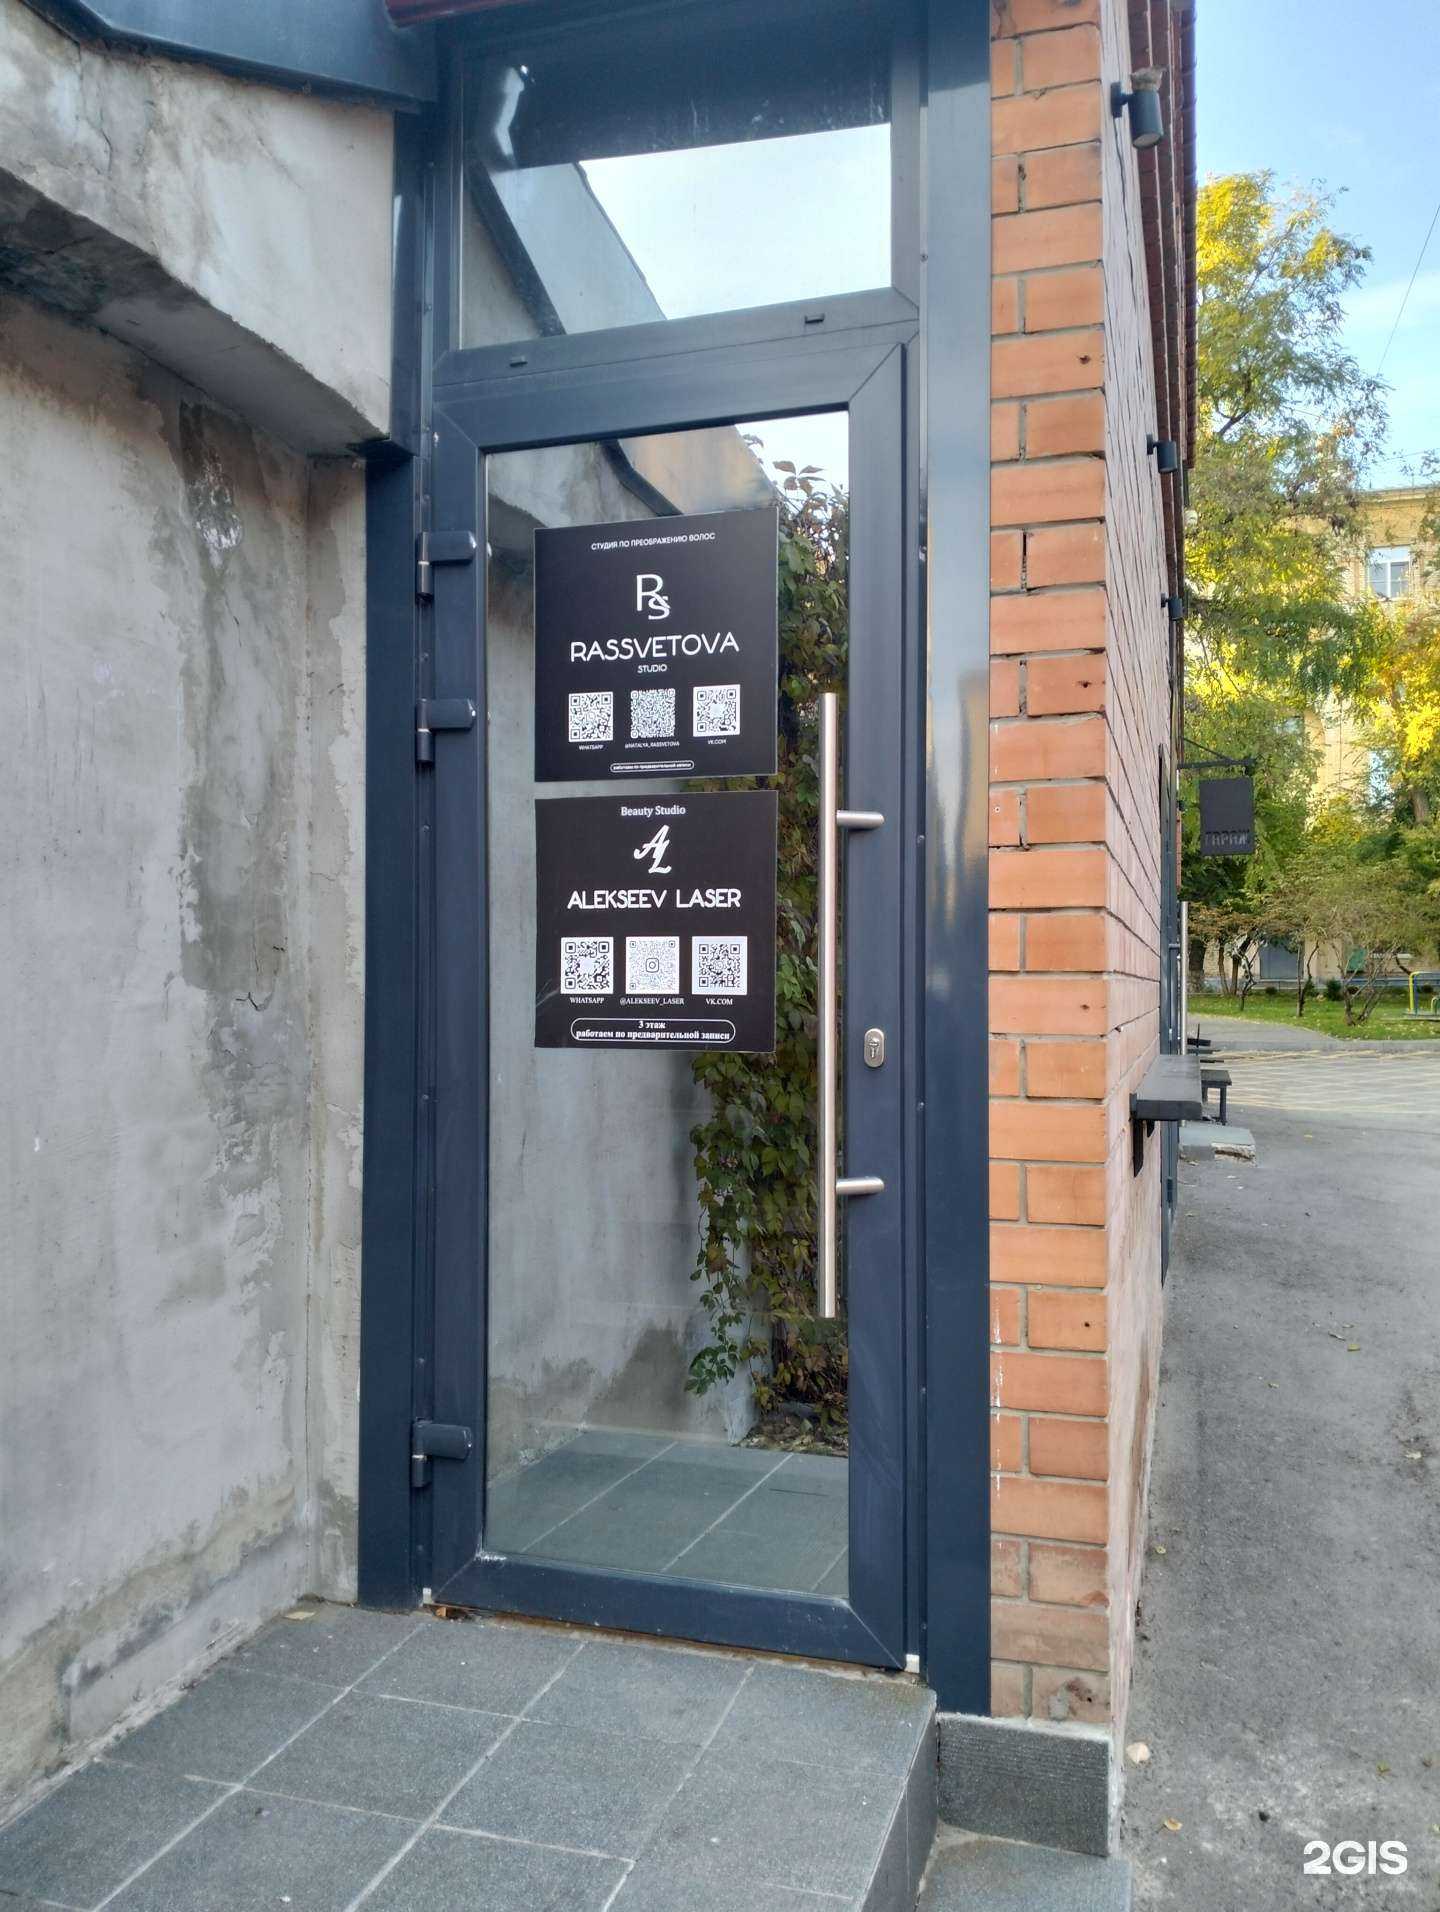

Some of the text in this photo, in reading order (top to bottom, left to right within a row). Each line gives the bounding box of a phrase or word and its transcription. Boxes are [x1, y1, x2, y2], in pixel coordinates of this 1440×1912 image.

[591, 532, 716, 550] СТУДИЯ ПО ПРЕОБРАЖЕНИЮ ВОЛОС
[570, 631, 740, 663] RASSVETOVA
[637, 664, 668, 674] STUDIO
[620, 804, 687, 817] Beauty Studio
[567, 888, 742, 909] ALEKSEEV LASER
[619, 997, 685, 1006] @ALEKSEEV_LASER
[705, 997, 733, 1005] VK.COM
[638, 1020, 643, 1028] 3
[576, 1030, 613, 1039] работаем
[627, 1030, 700, 1040] предварительной
